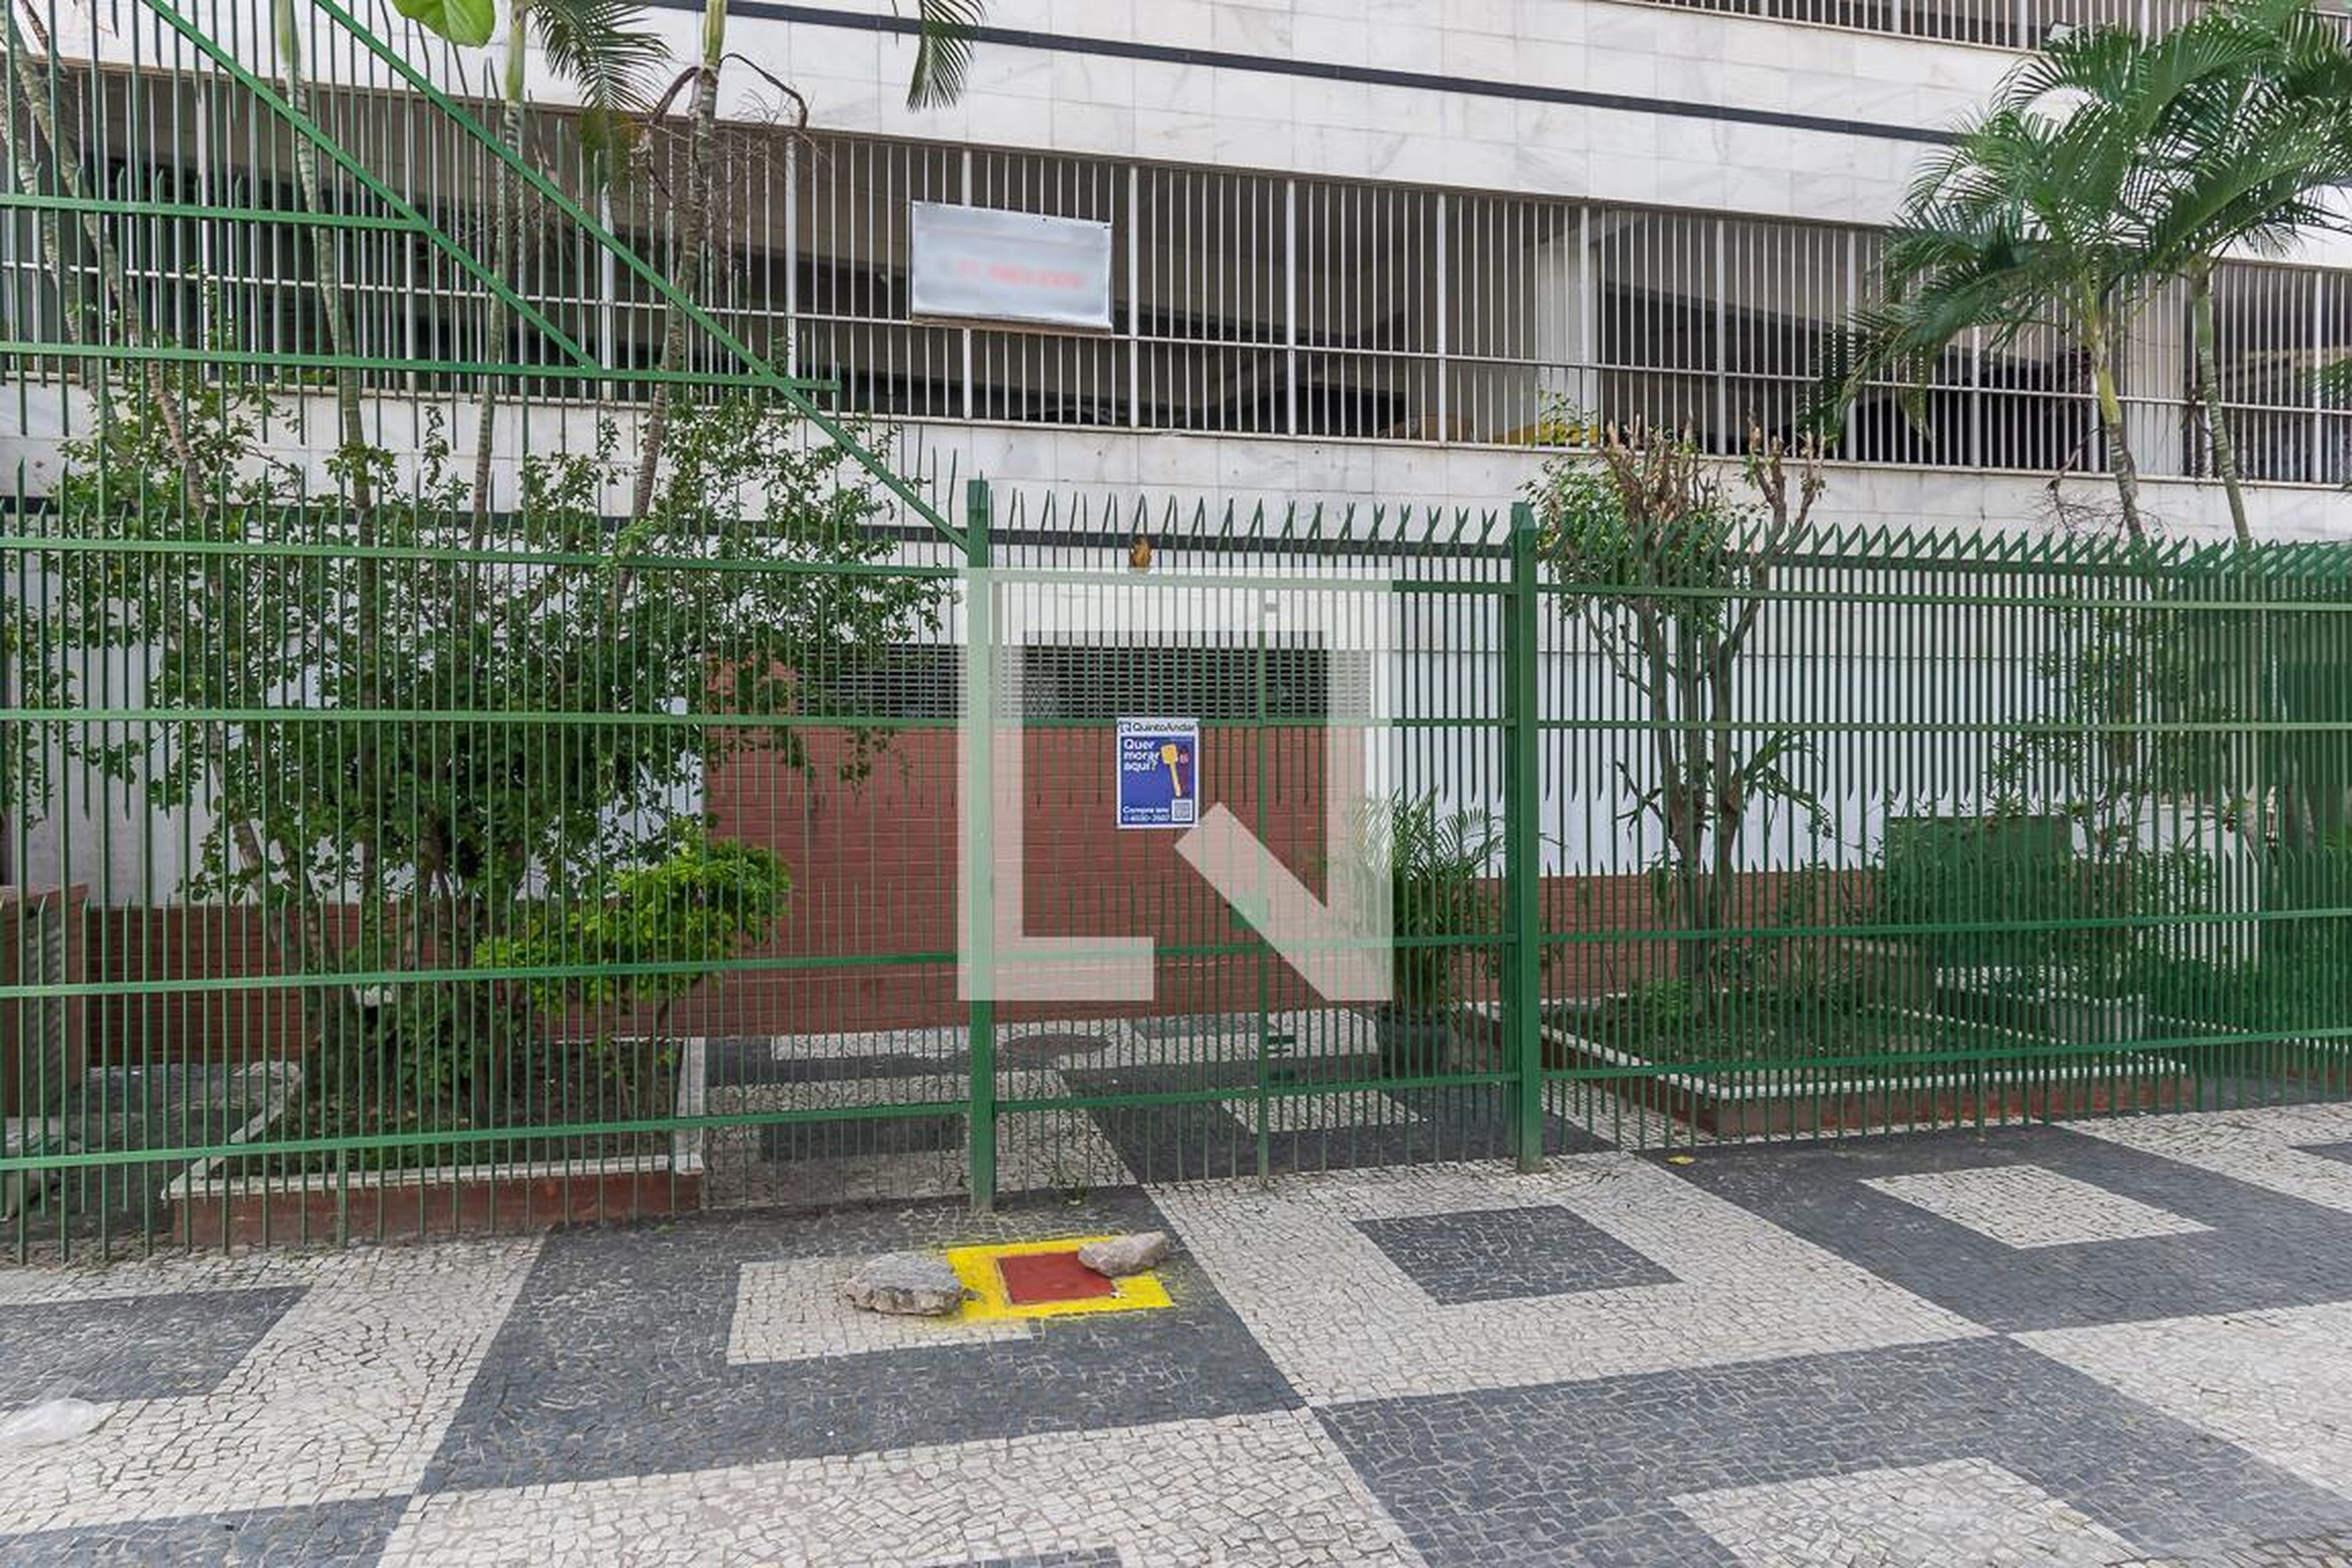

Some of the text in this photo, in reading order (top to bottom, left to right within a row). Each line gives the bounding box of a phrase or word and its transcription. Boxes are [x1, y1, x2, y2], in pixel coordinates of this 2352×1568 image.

[1133, 722, 1194, 732] QuintoAndar
[1124, 739, 1155, 750] Quer
[1124, 751, 1160, 761] morar
[1123, 761, 1158, 772] aqui?
